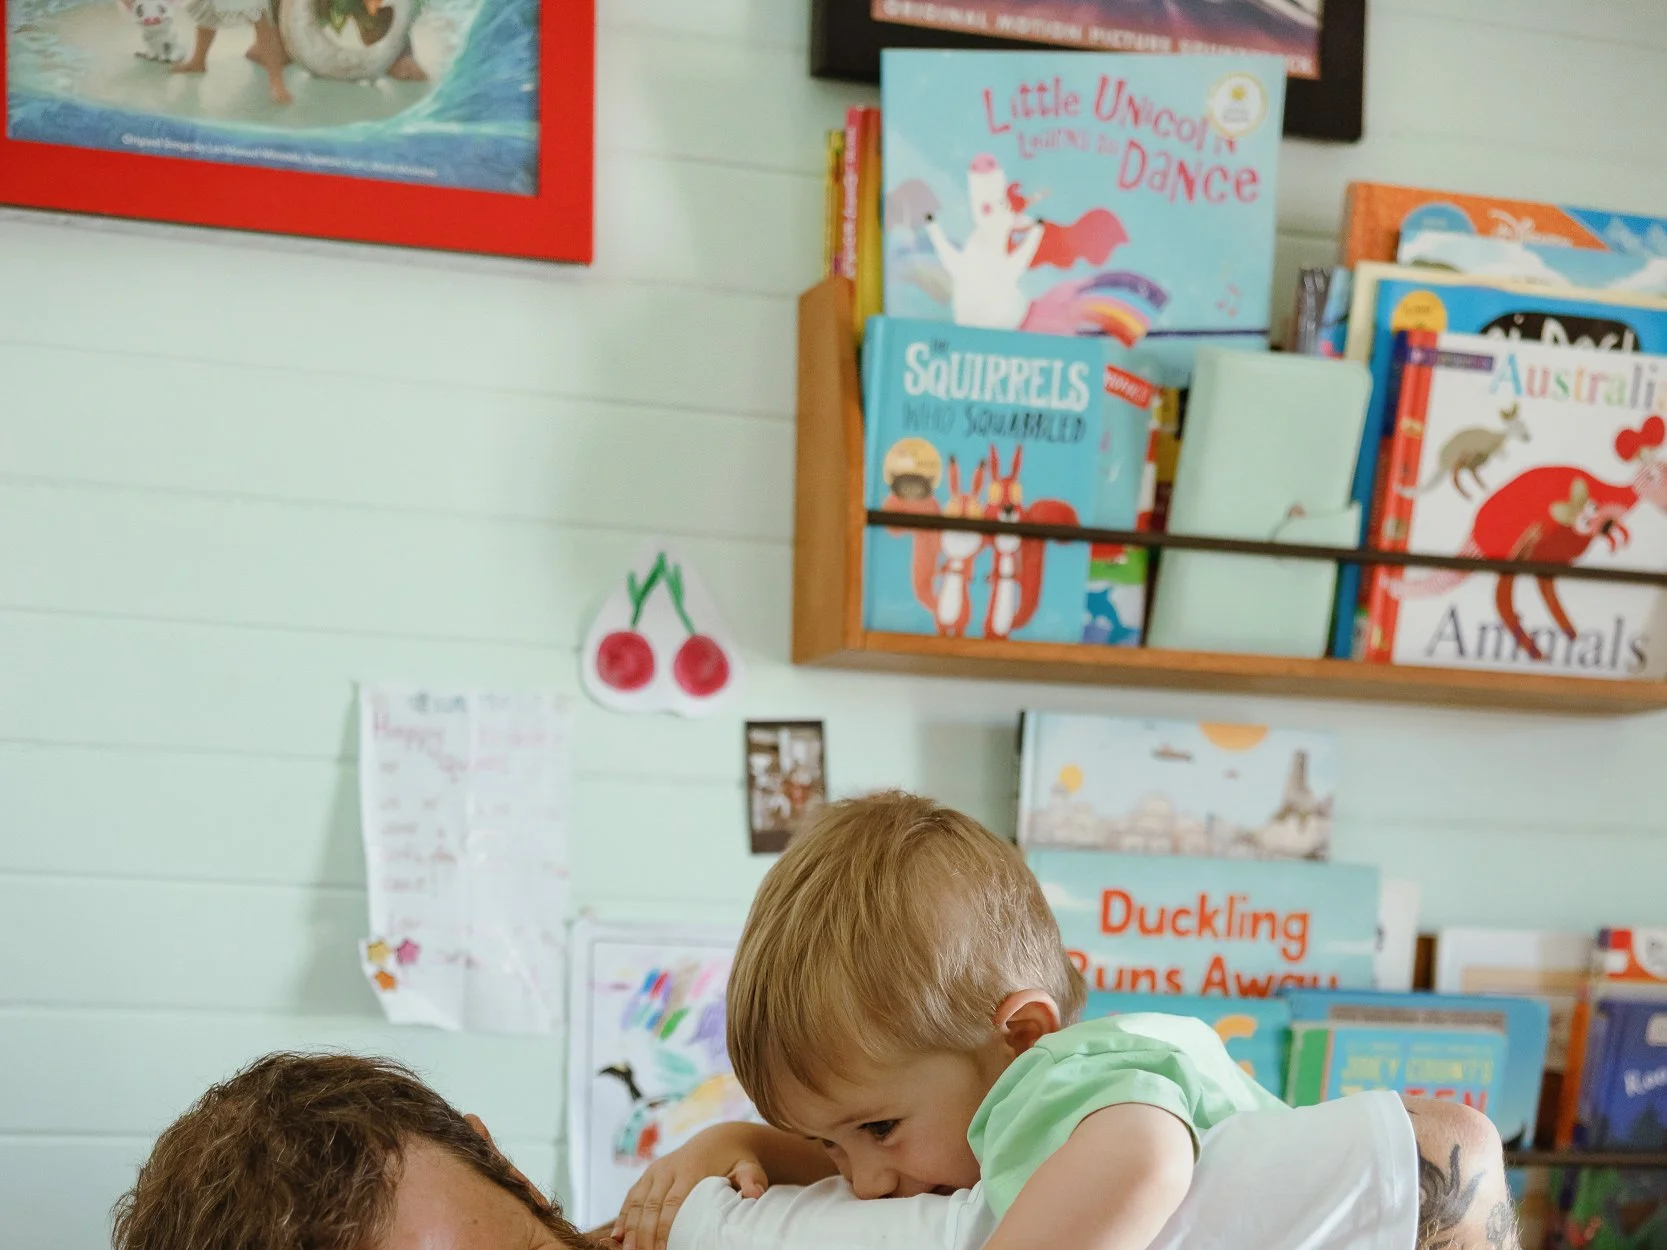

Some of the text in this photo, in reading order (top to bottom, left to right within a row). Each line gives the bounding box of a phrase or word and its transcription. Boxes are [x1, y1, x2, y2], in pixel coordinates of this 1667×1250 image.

[995, 14, 1083, 41] MOTION
[1089, 25, 1172, 53] PICTURE
[983, 76, 1081, 135] Little
[904, 341, 1090, 412] SQUIRRELS
[903, 401, 957, 435] WHO
[1099, 888, 1311, 963] Duckling
